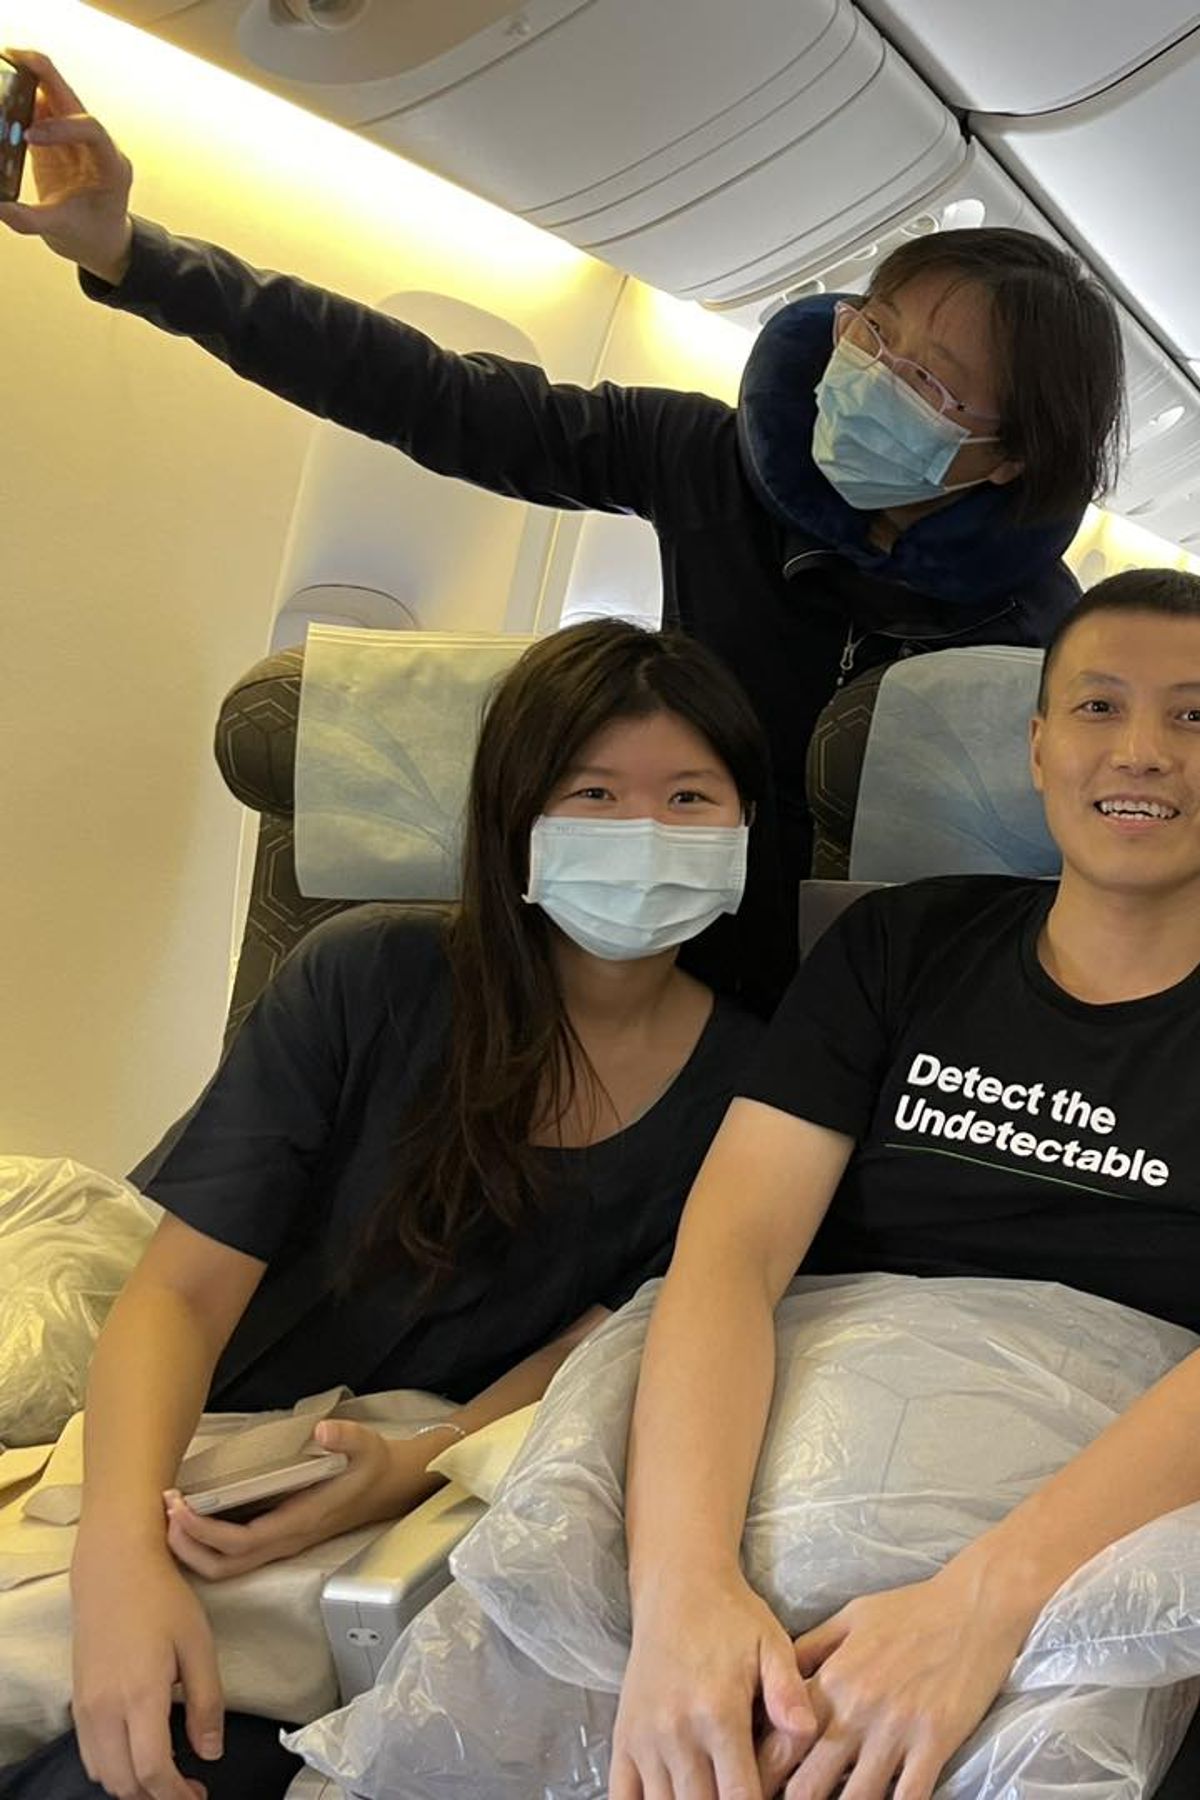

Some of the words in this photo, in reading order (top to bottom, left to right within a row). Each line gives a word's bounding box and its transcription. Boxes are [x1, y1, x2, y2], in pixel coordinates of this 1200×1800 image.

[906, 1052, 1046, 1116] Detect
[1050, 1089, 1117, 1135] the
[894, 1094, 1170, 1187] Undetectable
